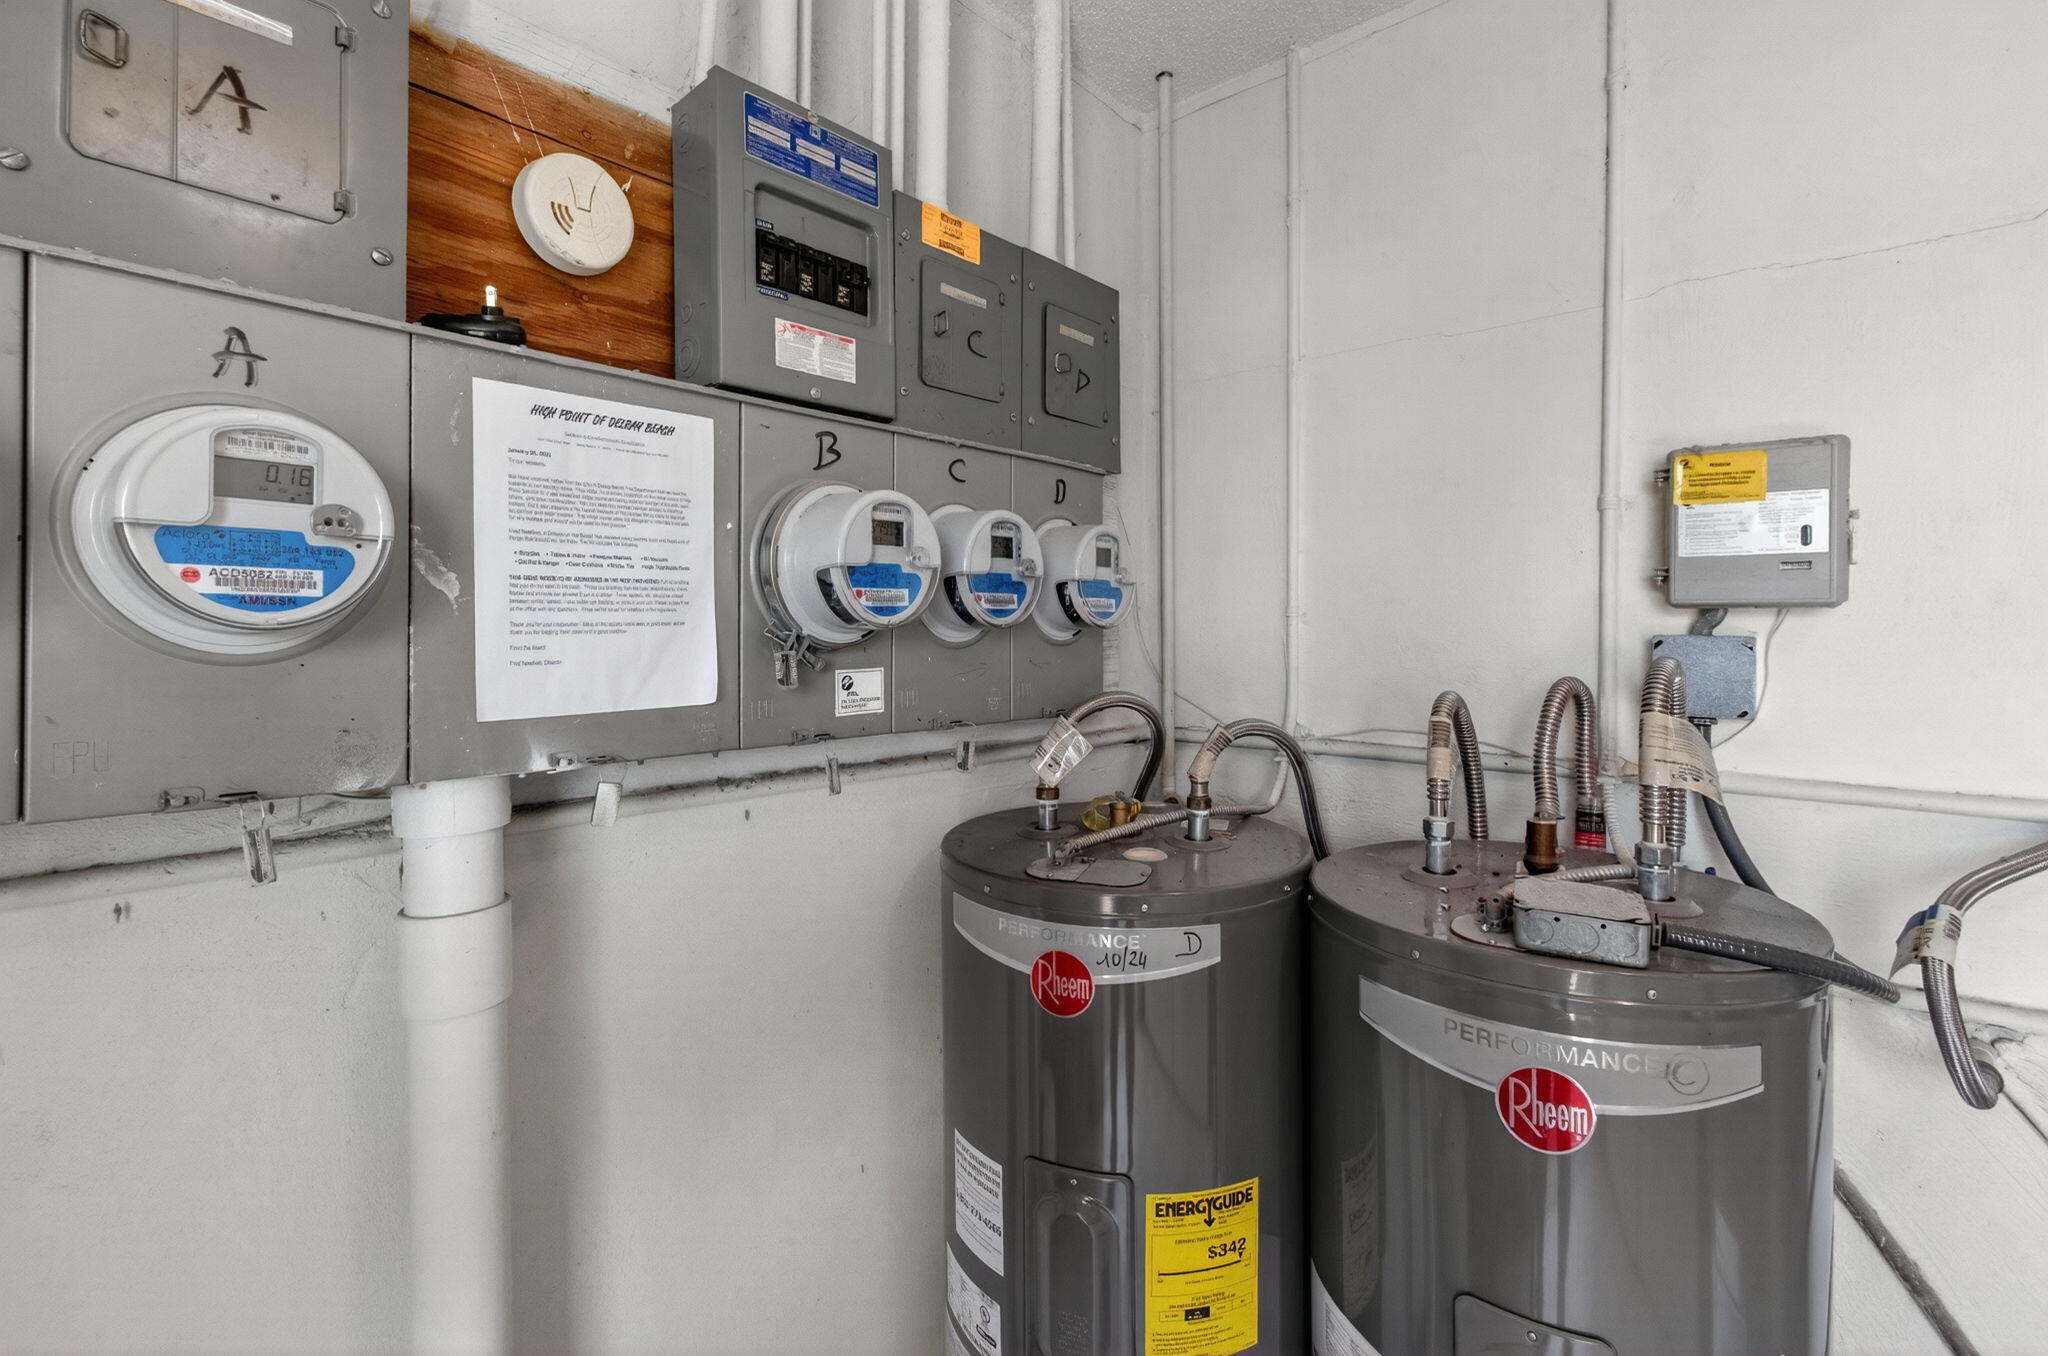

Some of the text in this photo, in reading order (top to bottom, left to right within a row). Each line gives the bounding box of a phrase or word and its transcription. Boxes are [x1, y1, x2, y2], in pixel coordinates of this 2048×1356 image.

[185, 65, 268, 135] A
[211, 326, 268, 387] A
[967, 330, 988, 358] C
[1075, 369, 1091, 393] D
[531, 404, 675, 436] HIGH POINT OF DELRAY BEACH
[812, 431, 842, 471] B
[948, 459, 966, 483] C
[1054, 479, 1067, 504] D
[998, 917, 1141, 949] PERFORMANCE
[1175, 931, 1203, 958] D
[1096, 946, 1148, 971] 10/24
[1038, 950, 1090, 1005] Rheem
[1444, 1018, 1663, 1077] PERFORMANCE
[1508, 1067, 1589, 1139] Rheem
[1155, 1186, 1254, 1224] ENERGYGUIDE
